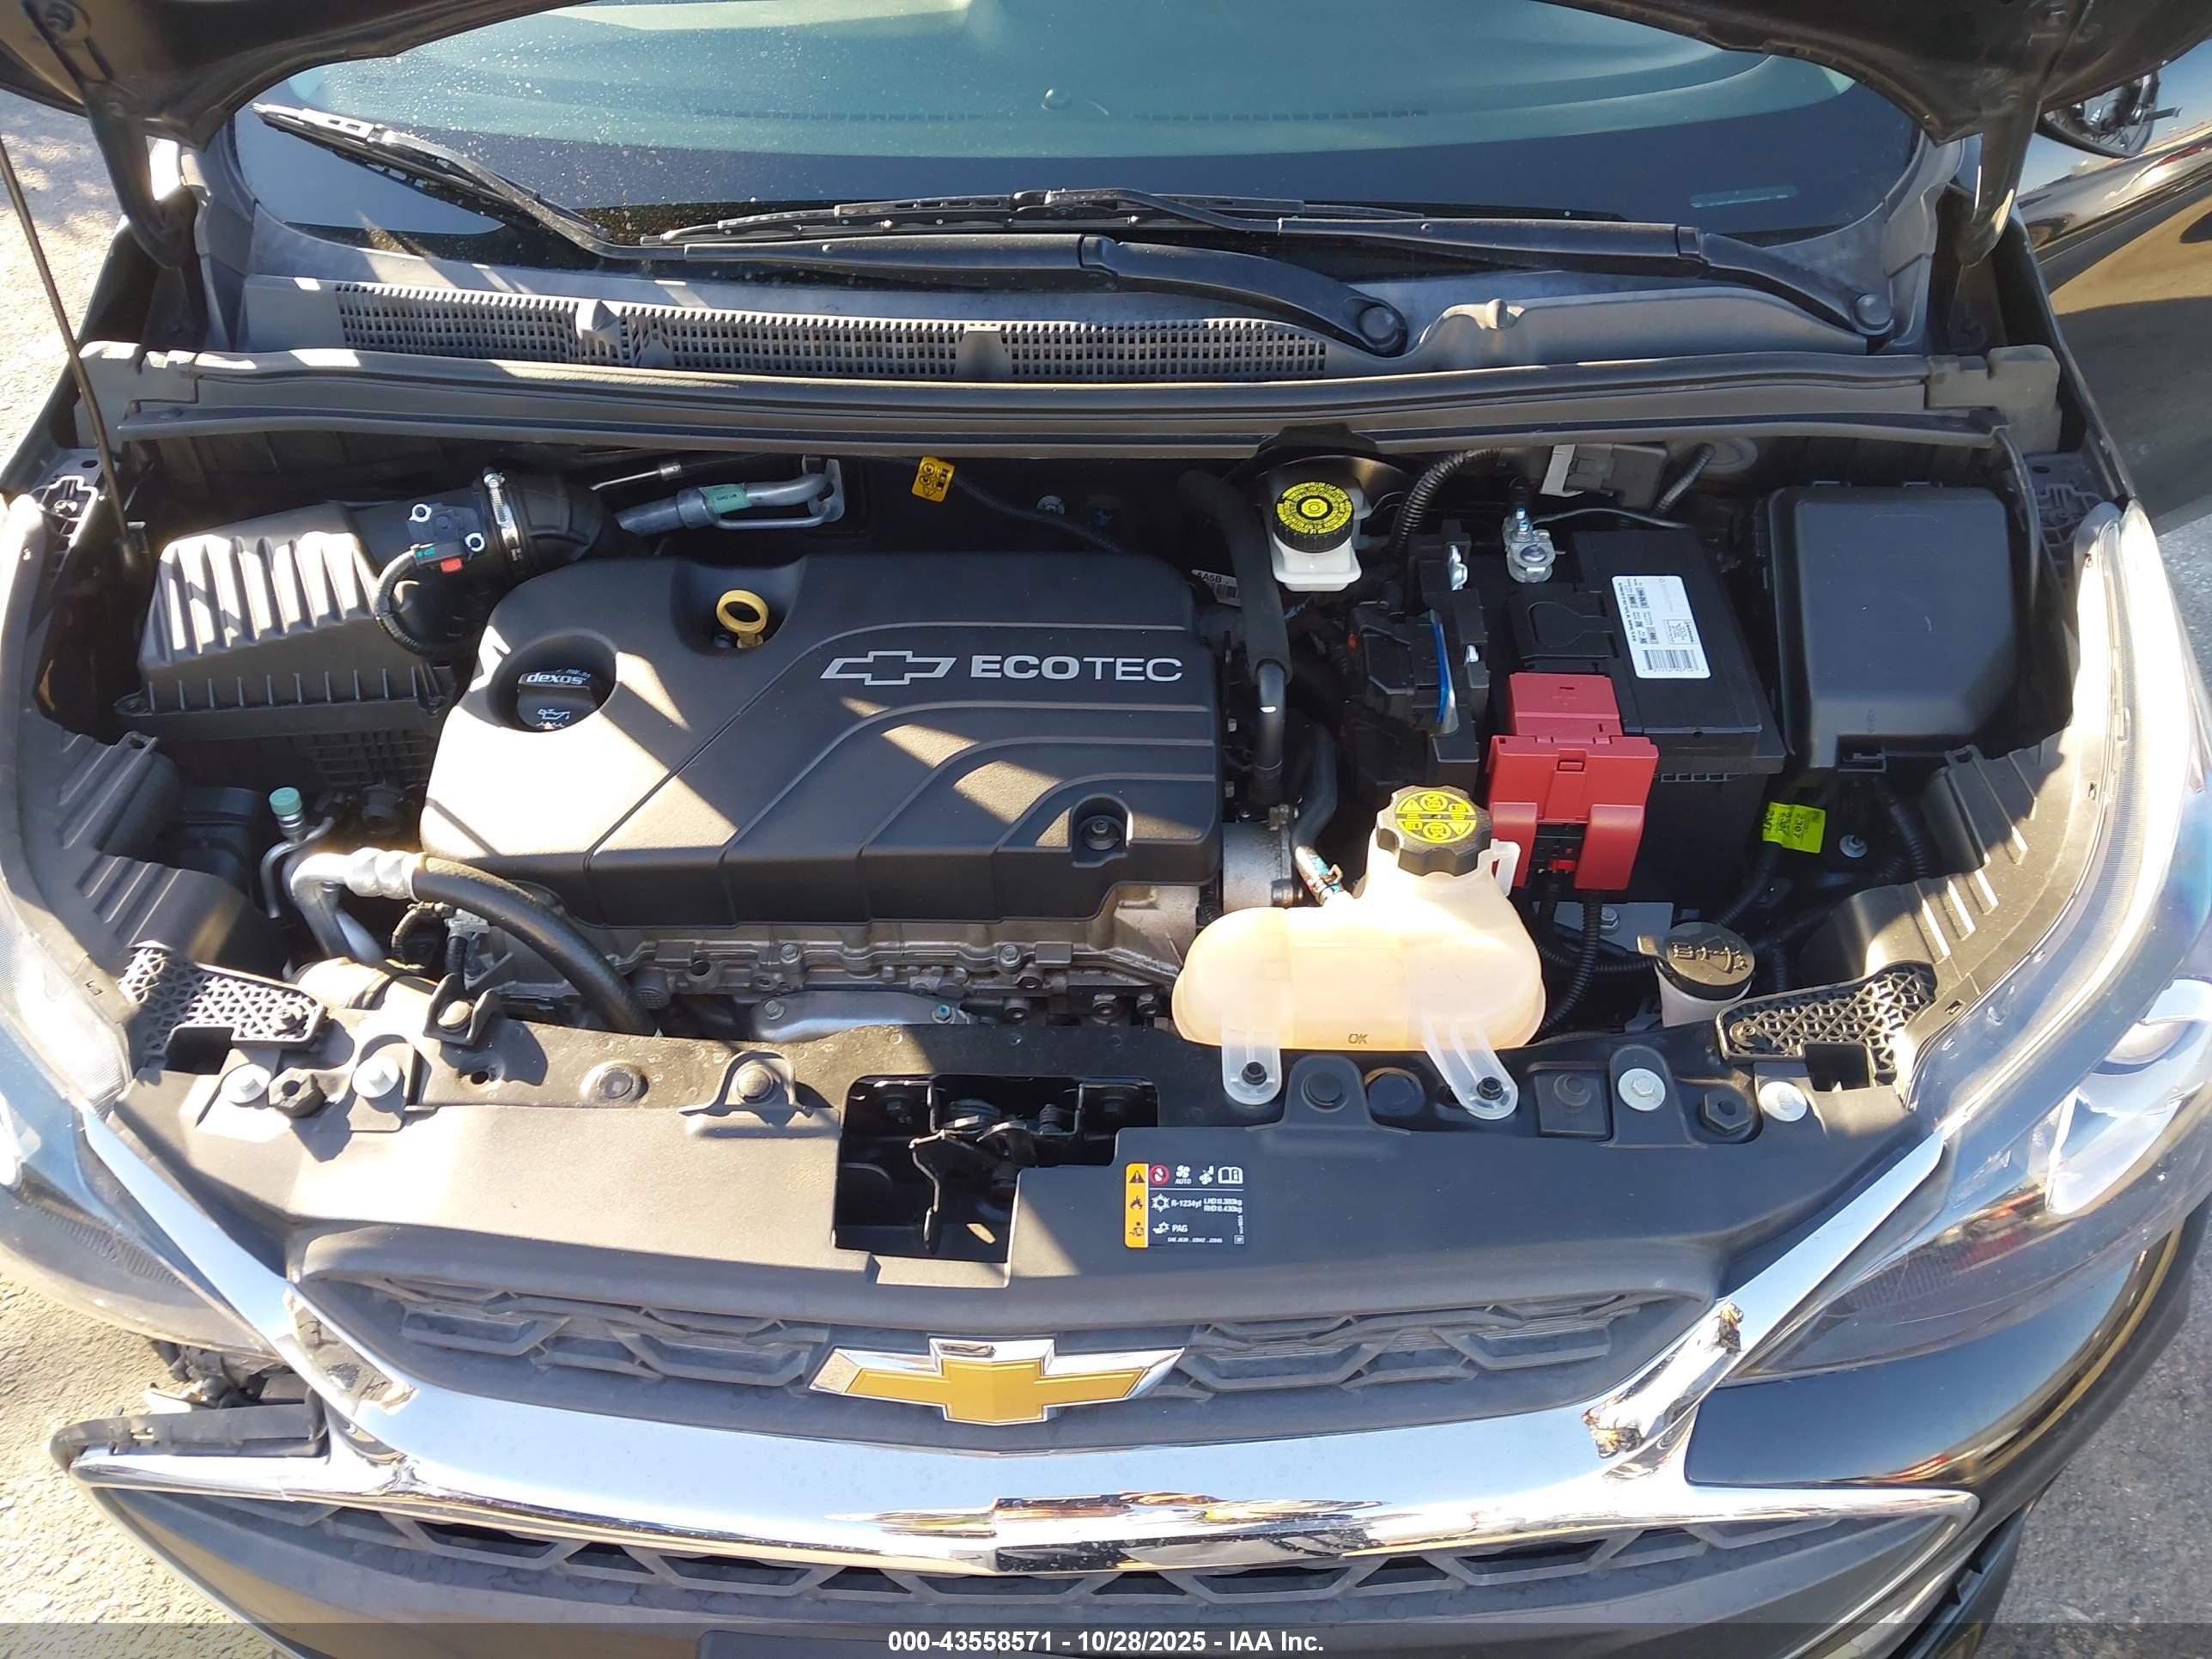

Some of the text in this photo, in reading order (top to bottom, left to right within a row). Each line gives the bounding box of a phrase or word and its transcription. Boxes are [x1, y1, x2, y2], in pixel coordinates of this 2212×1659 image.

[970, 654, 1182, 683] ECOTEC
[526, 672, 585, 684] dexos
[1348, 1033, 1369, 1044] OK
[1170, 1199, 1202, 1209] R-1234yf
[1171, 1224, 1188, 1232] PAG
